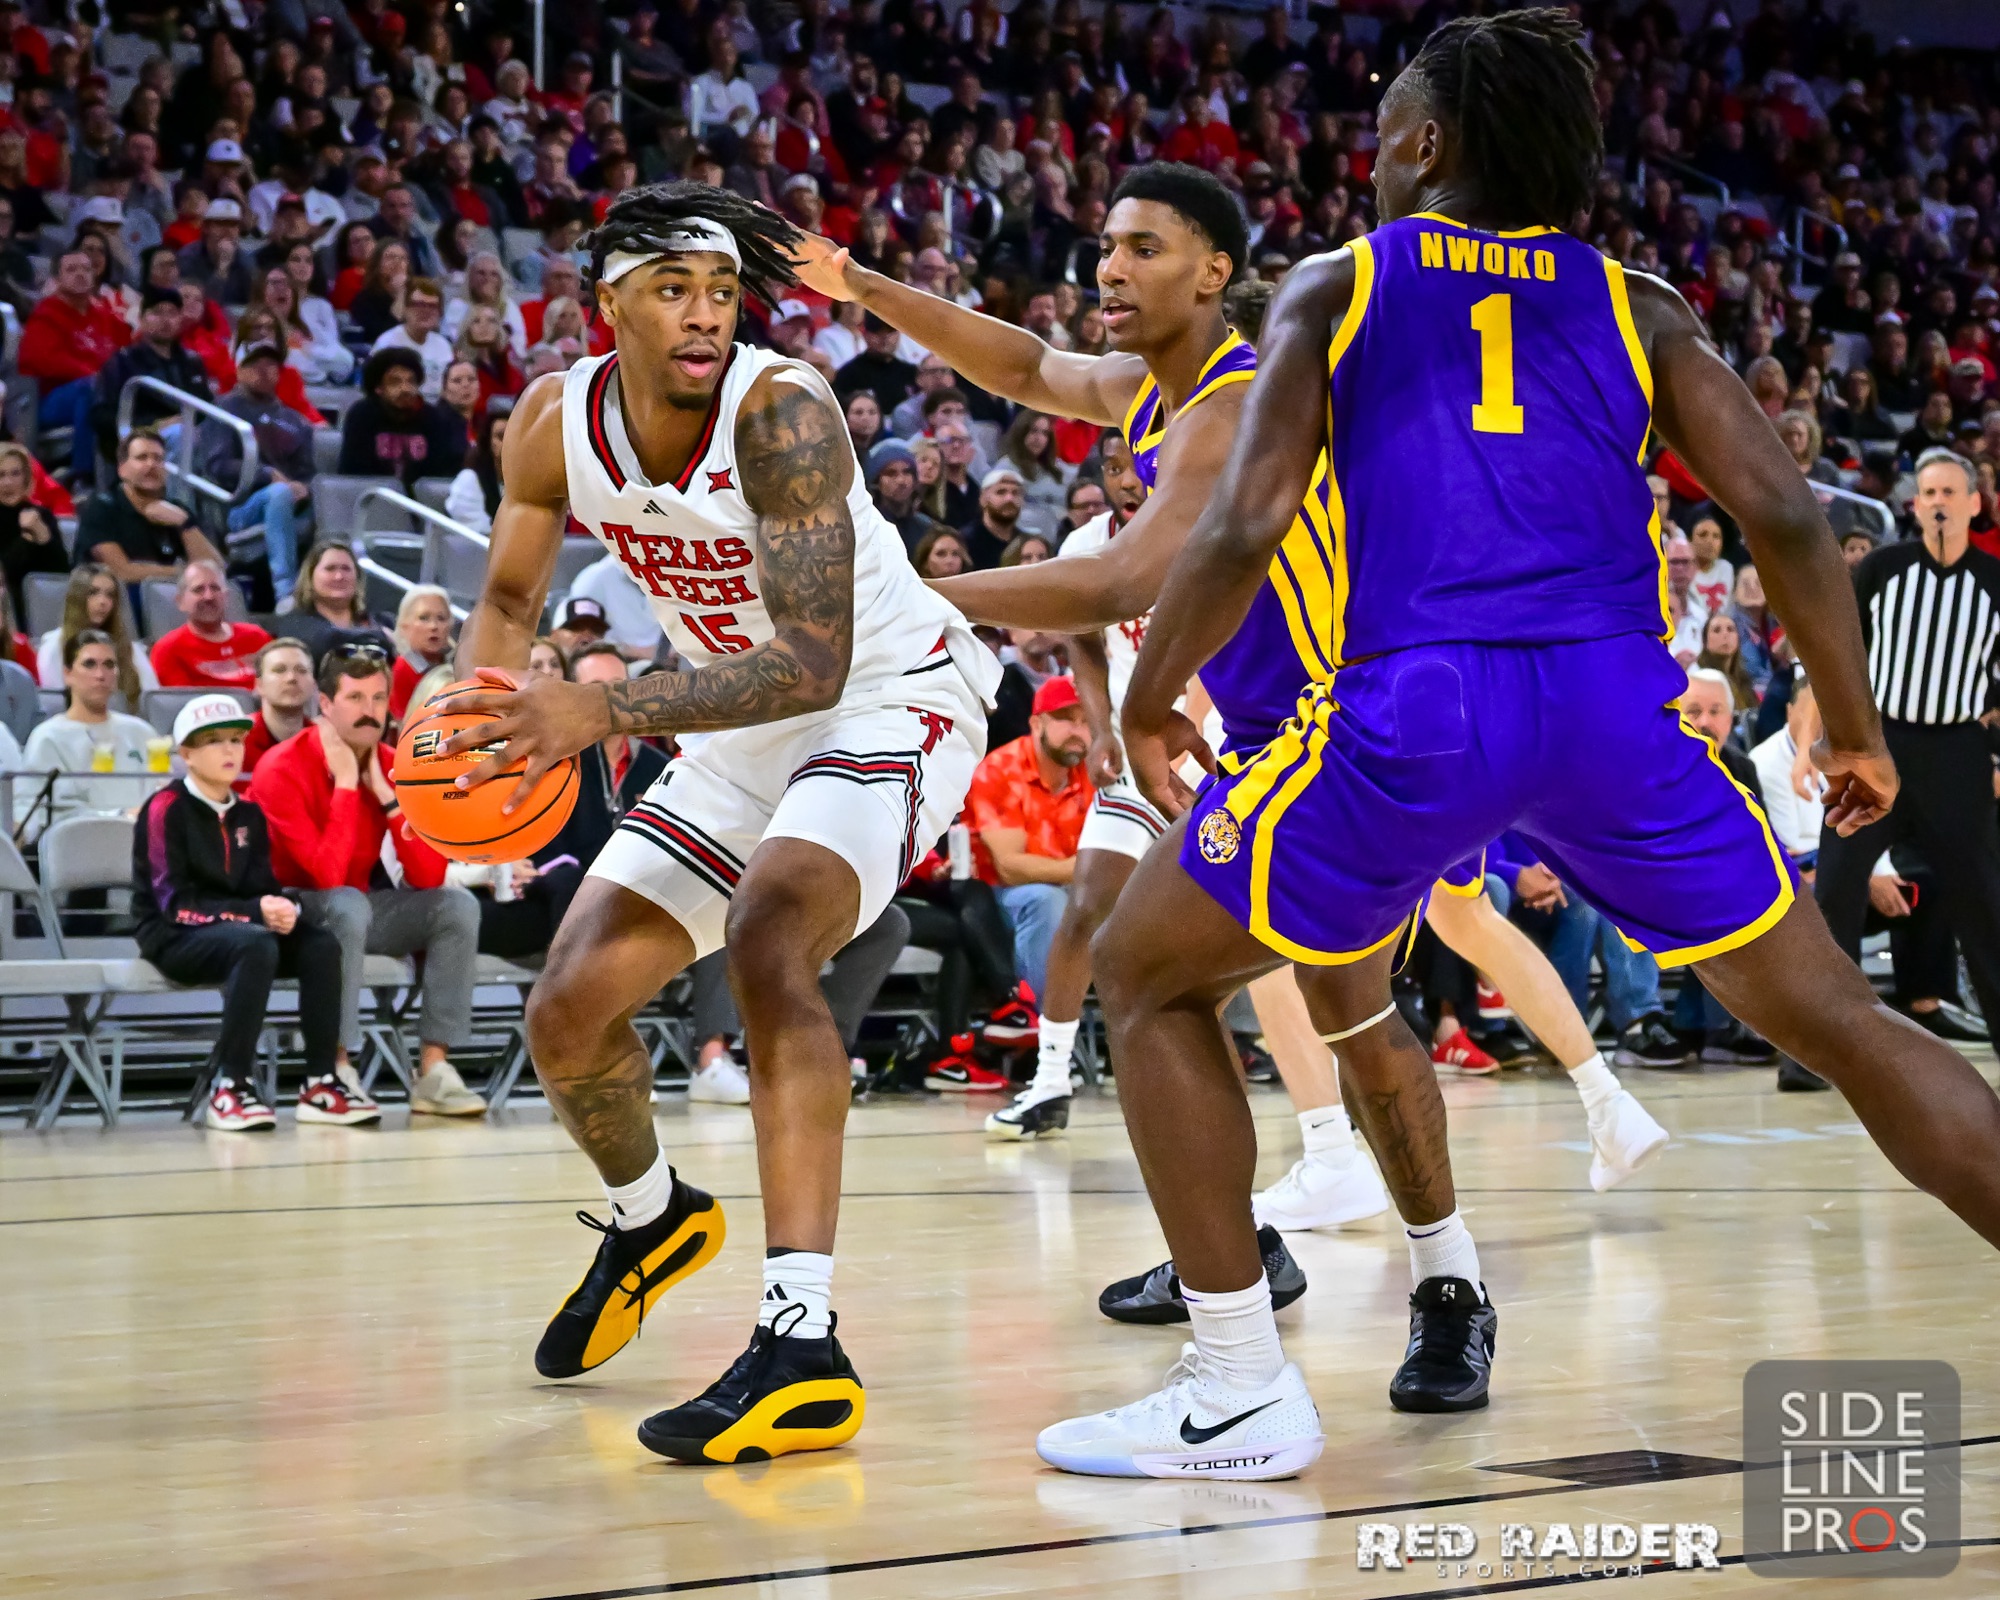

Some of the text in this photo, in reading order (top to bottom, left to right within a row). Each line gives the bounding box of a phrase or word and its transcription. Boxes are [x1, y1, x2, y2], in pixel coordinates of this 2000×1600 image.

[1419, 231, 1556, 282] NWOKO
[1470, 293, 1524, 435] 1
[600, 522, 754, 572] TEXAS
[629, 563, 759, 606] TECH
[679, 612, 754, 654] 15
